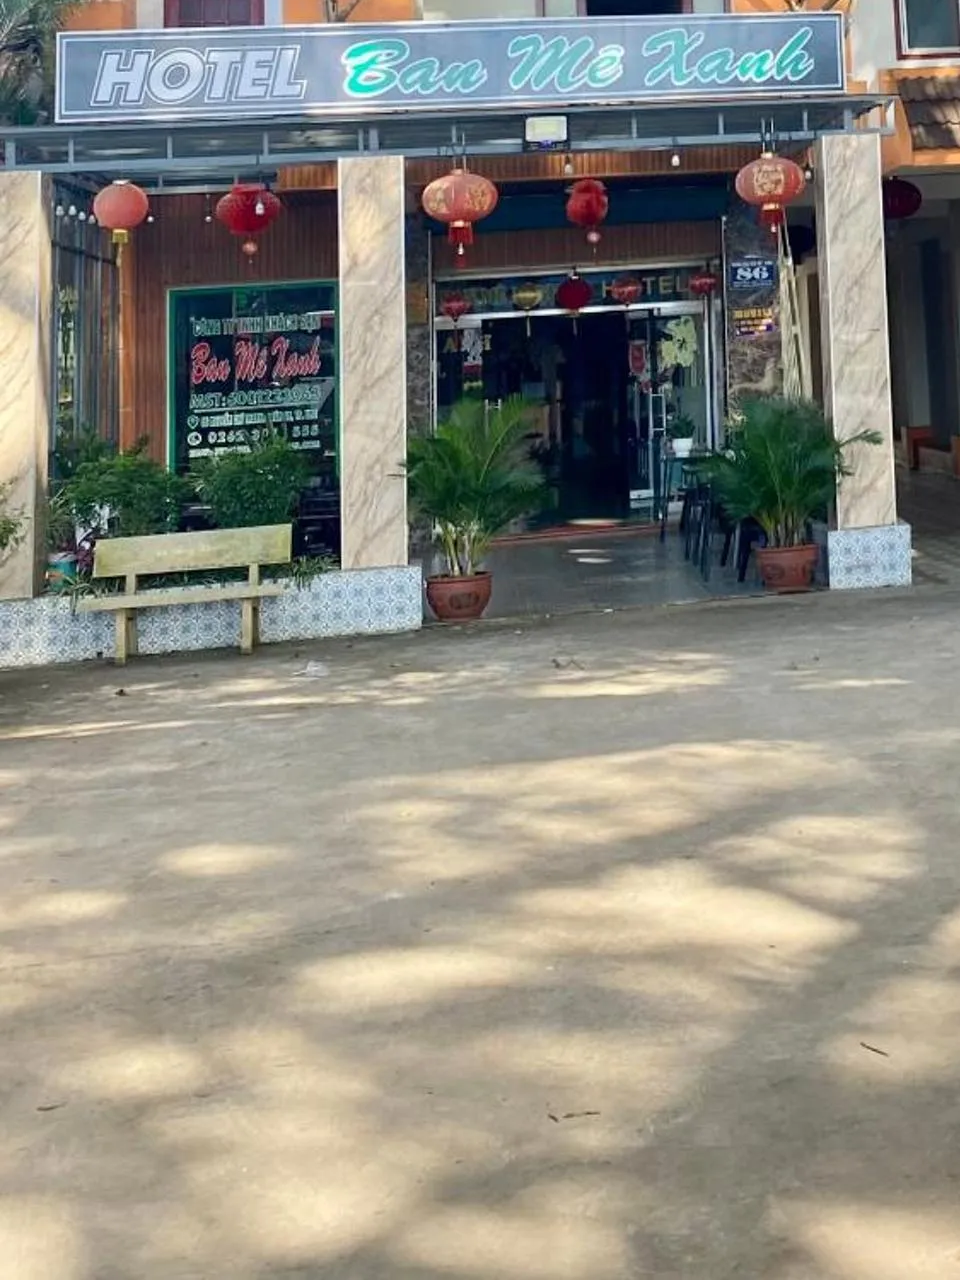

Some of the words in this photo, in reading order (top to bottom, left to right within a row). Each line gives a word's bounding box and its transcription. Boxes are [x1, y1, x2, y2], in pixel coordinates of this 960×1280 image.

[91, 46, 308, 107] HOTEL
[341, 38, 488, 98] Ban
[507, 33, 625, 93] Mê
[642, 26, 817, 90] Xanh
[736, 266, 769, 281] 86
